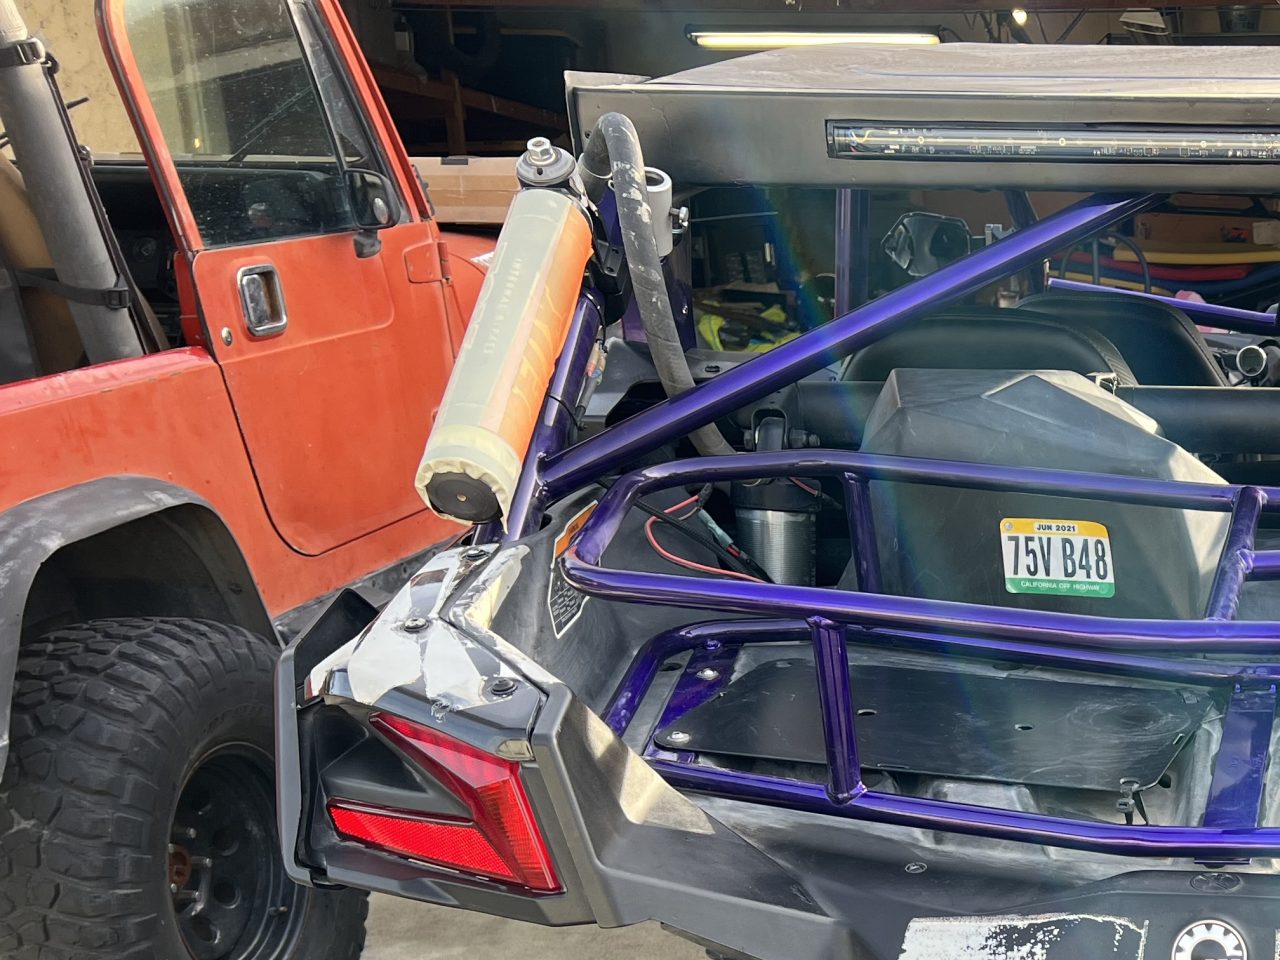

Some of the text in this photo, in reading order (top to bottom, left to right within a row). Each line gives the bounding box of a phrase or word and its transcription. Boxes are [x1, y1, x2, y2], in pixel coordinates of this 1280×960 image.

[1036, 523, 1076, 532] JUN 2021
[1007, 535, 1108, 580] 75V B48
[1020, 580, 1057, 589] CALIFORNIA
